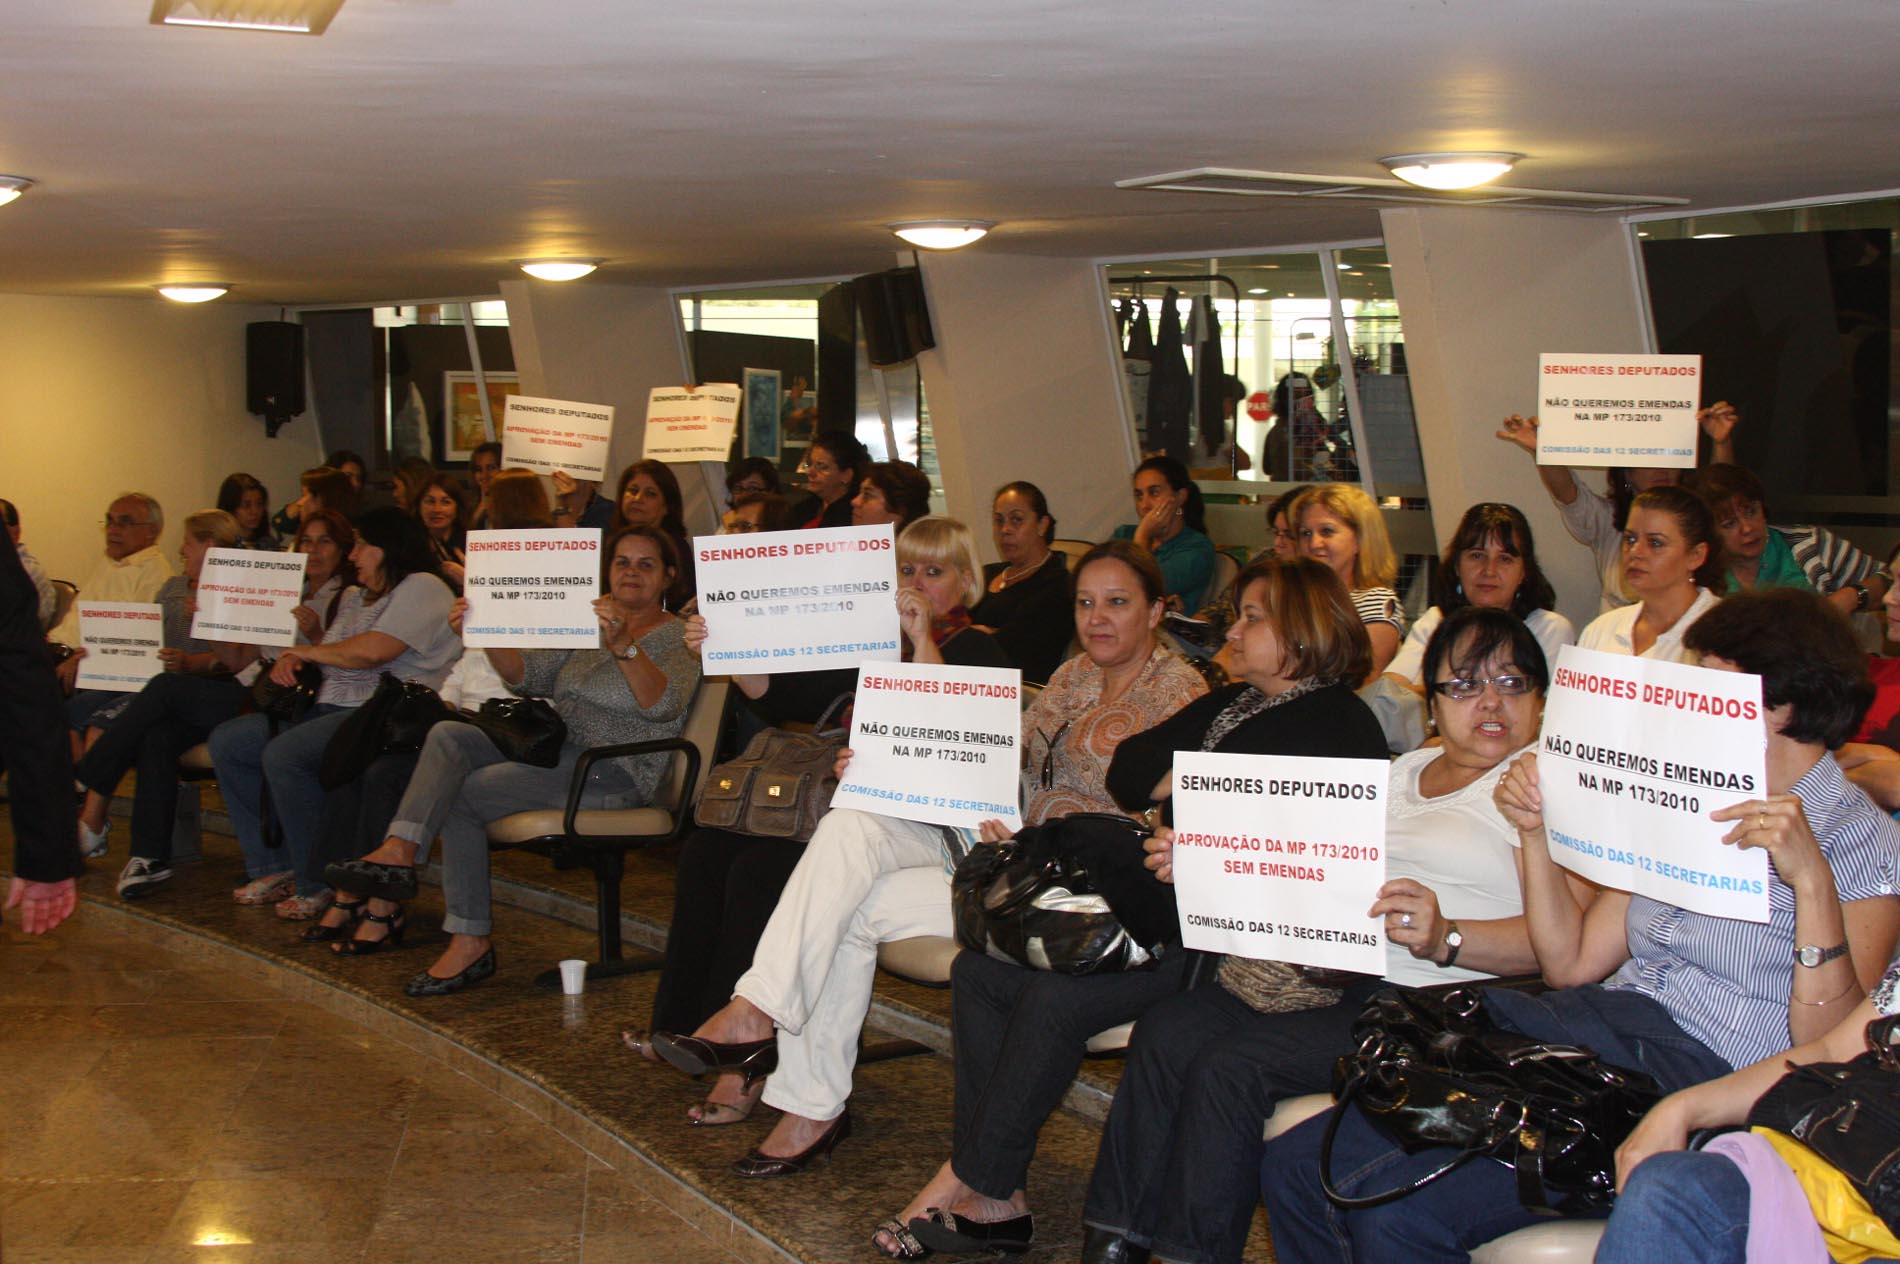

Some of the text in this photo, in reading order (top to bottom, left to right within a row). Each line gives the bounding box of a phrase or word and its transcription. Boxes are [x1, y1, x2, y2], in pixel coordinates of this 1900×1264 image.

[1543, 365, 1696, 376] SENHORES DEPUTADOS
[510, 403, 609, 420] SENHORES DEPUTADOS
[1545, 397, 1692, 408] NÃO QUEREMOS EMENDAS
[1574, 413, 1662, 422] NA MP 173/2010
[469, 540, 597, 551] SENHORES DEPUTADOS
[700, 538, 891, 562] SENHORES DEPUTADOS
[208, 558, 302, 571] SENHORES DEPUTADOS
[469, 576, 593, 585] NÃO QUEREMOS EMENDAS
[491, 591, 565, 600] NA MP 173/2010
[706, 581, 890, 603] NÃO QUEREMOS EMENDAS
[745, 607, 764, 617] NA
[768, 605, 789, 615] MP
[466, 626, 506, 635] COMISSÃO
[509, 627, 525, 635] DAS
[538, 627, 596, 635] SECRETARIAS
[708, 640, 896, 660] COMISSÃO DAS 12 SECRETARIAS
[863, 676, 1017, 699] SENHORES DEPUTADOS
[1555, 667, 1757, 721] SENHORES DEPUTADOS
[860, 722, 1013, 747] NÃO QUEREMOS EMENDAS
[893, 745, 986, 764] NA MP 173/2010
[1545, 734, 1755, 791] NÃO QUEREMOS EMENDAS
[1181, 775, 1377, 800] SENHORES DEPUTADOS
[1579, 772, 1699, 814] NA MP 173/2010
[841, 783, 1016, 815] COMISSÃO DAS 12 SECRETARIAS
[1177, 832, 1379, 861] APROVAÇÃO DA MP 173/2010
[1224, 860, 1325, 882] SEM EMENDAS
[1550, 828, 1763, 895] COMISSÃO DAS 12 SECRETARIAS
[1187, 914, 1377, 947] COMISSÃO DAS 12 SECRETARIAS
